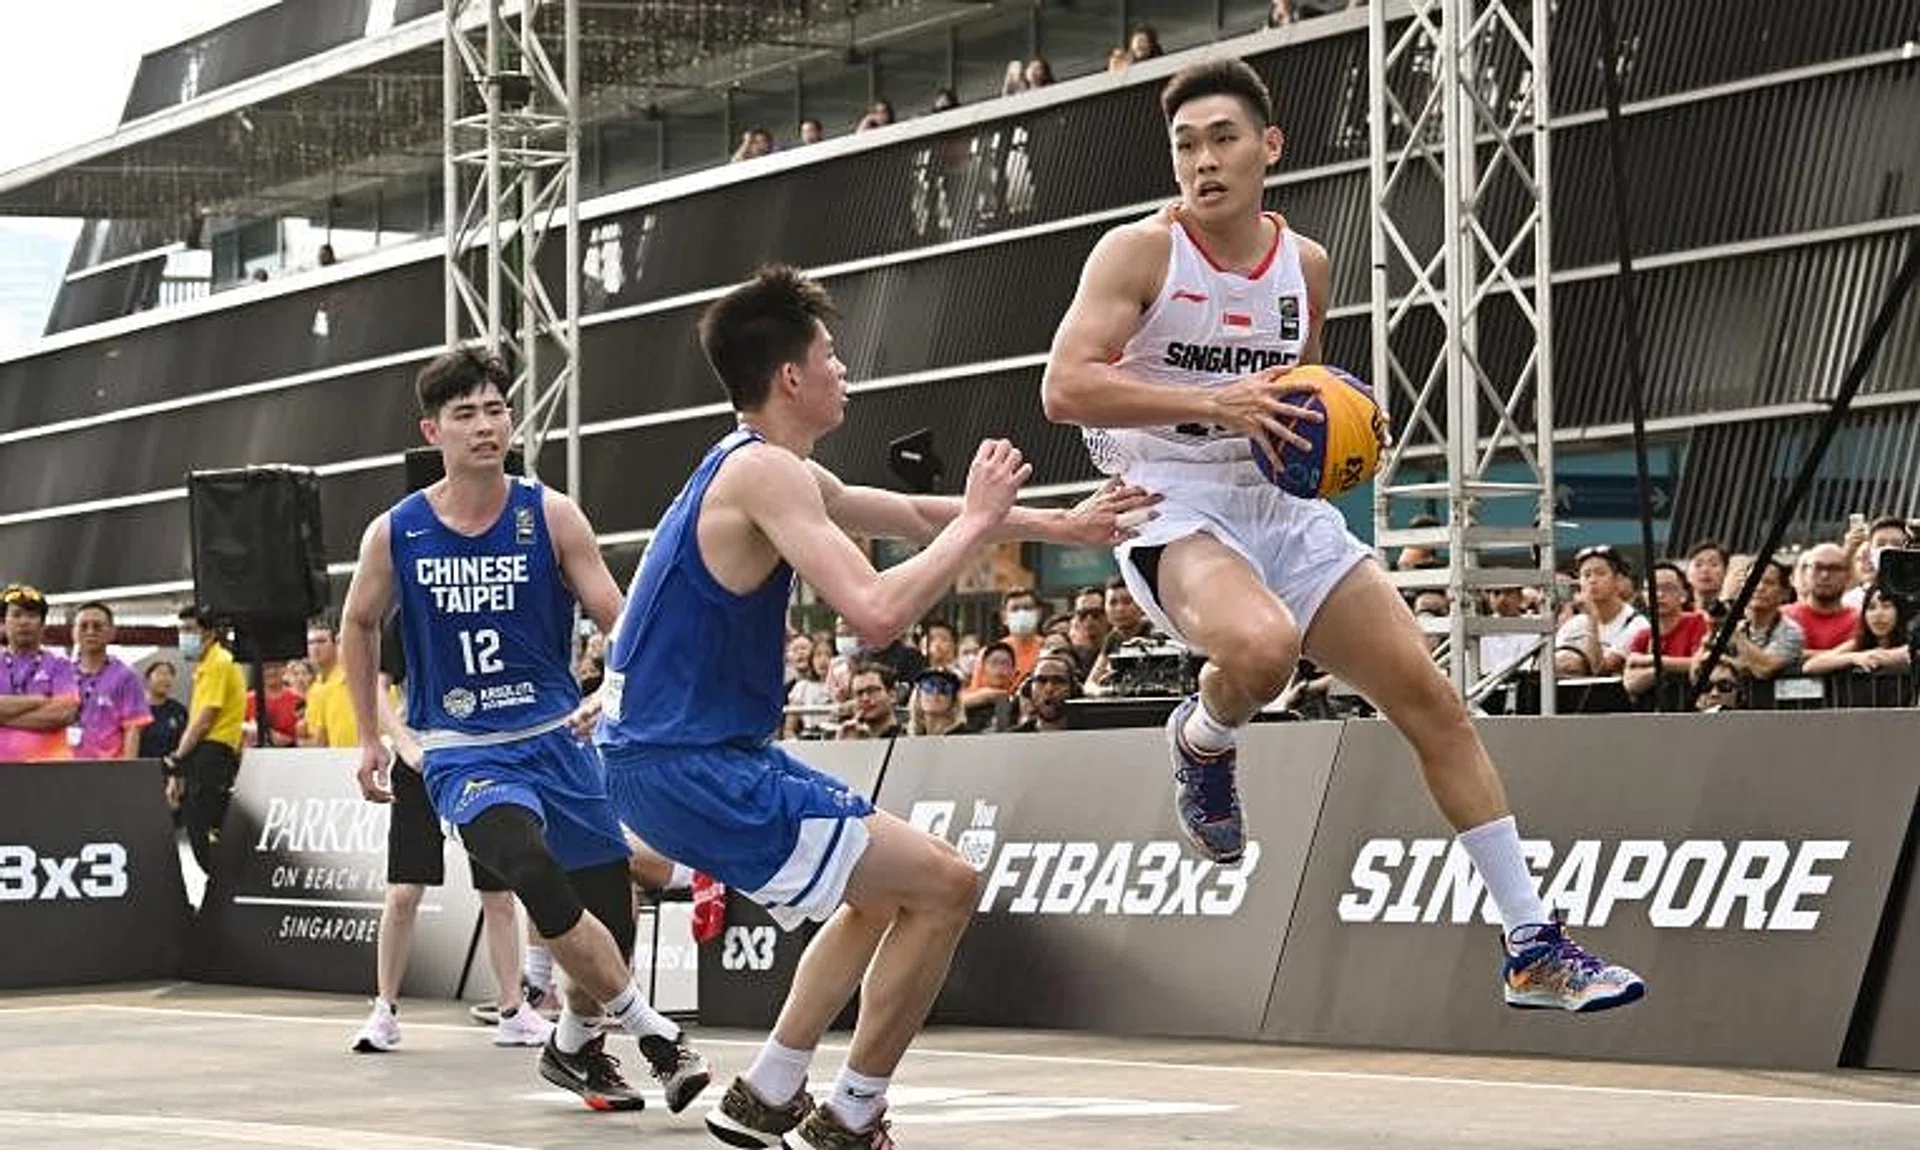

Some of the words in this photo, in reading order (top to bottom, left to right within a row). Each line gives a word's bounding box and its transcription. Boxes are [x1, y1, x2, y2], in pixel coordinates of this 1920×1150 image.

[416, 554, 529, 585] CHINESE
[431, 584, 515, 613] TAIPEI
[458, 628, 504, 676] 12
[256, 797, 389, 852] PARKRO
[271, 866, 298, 888] ON
[304, 867, 361, 890] BEACH
[977, 841, 1261, 915] FIBA3x3
[279, 916, 379, 943] SINGAPORE
